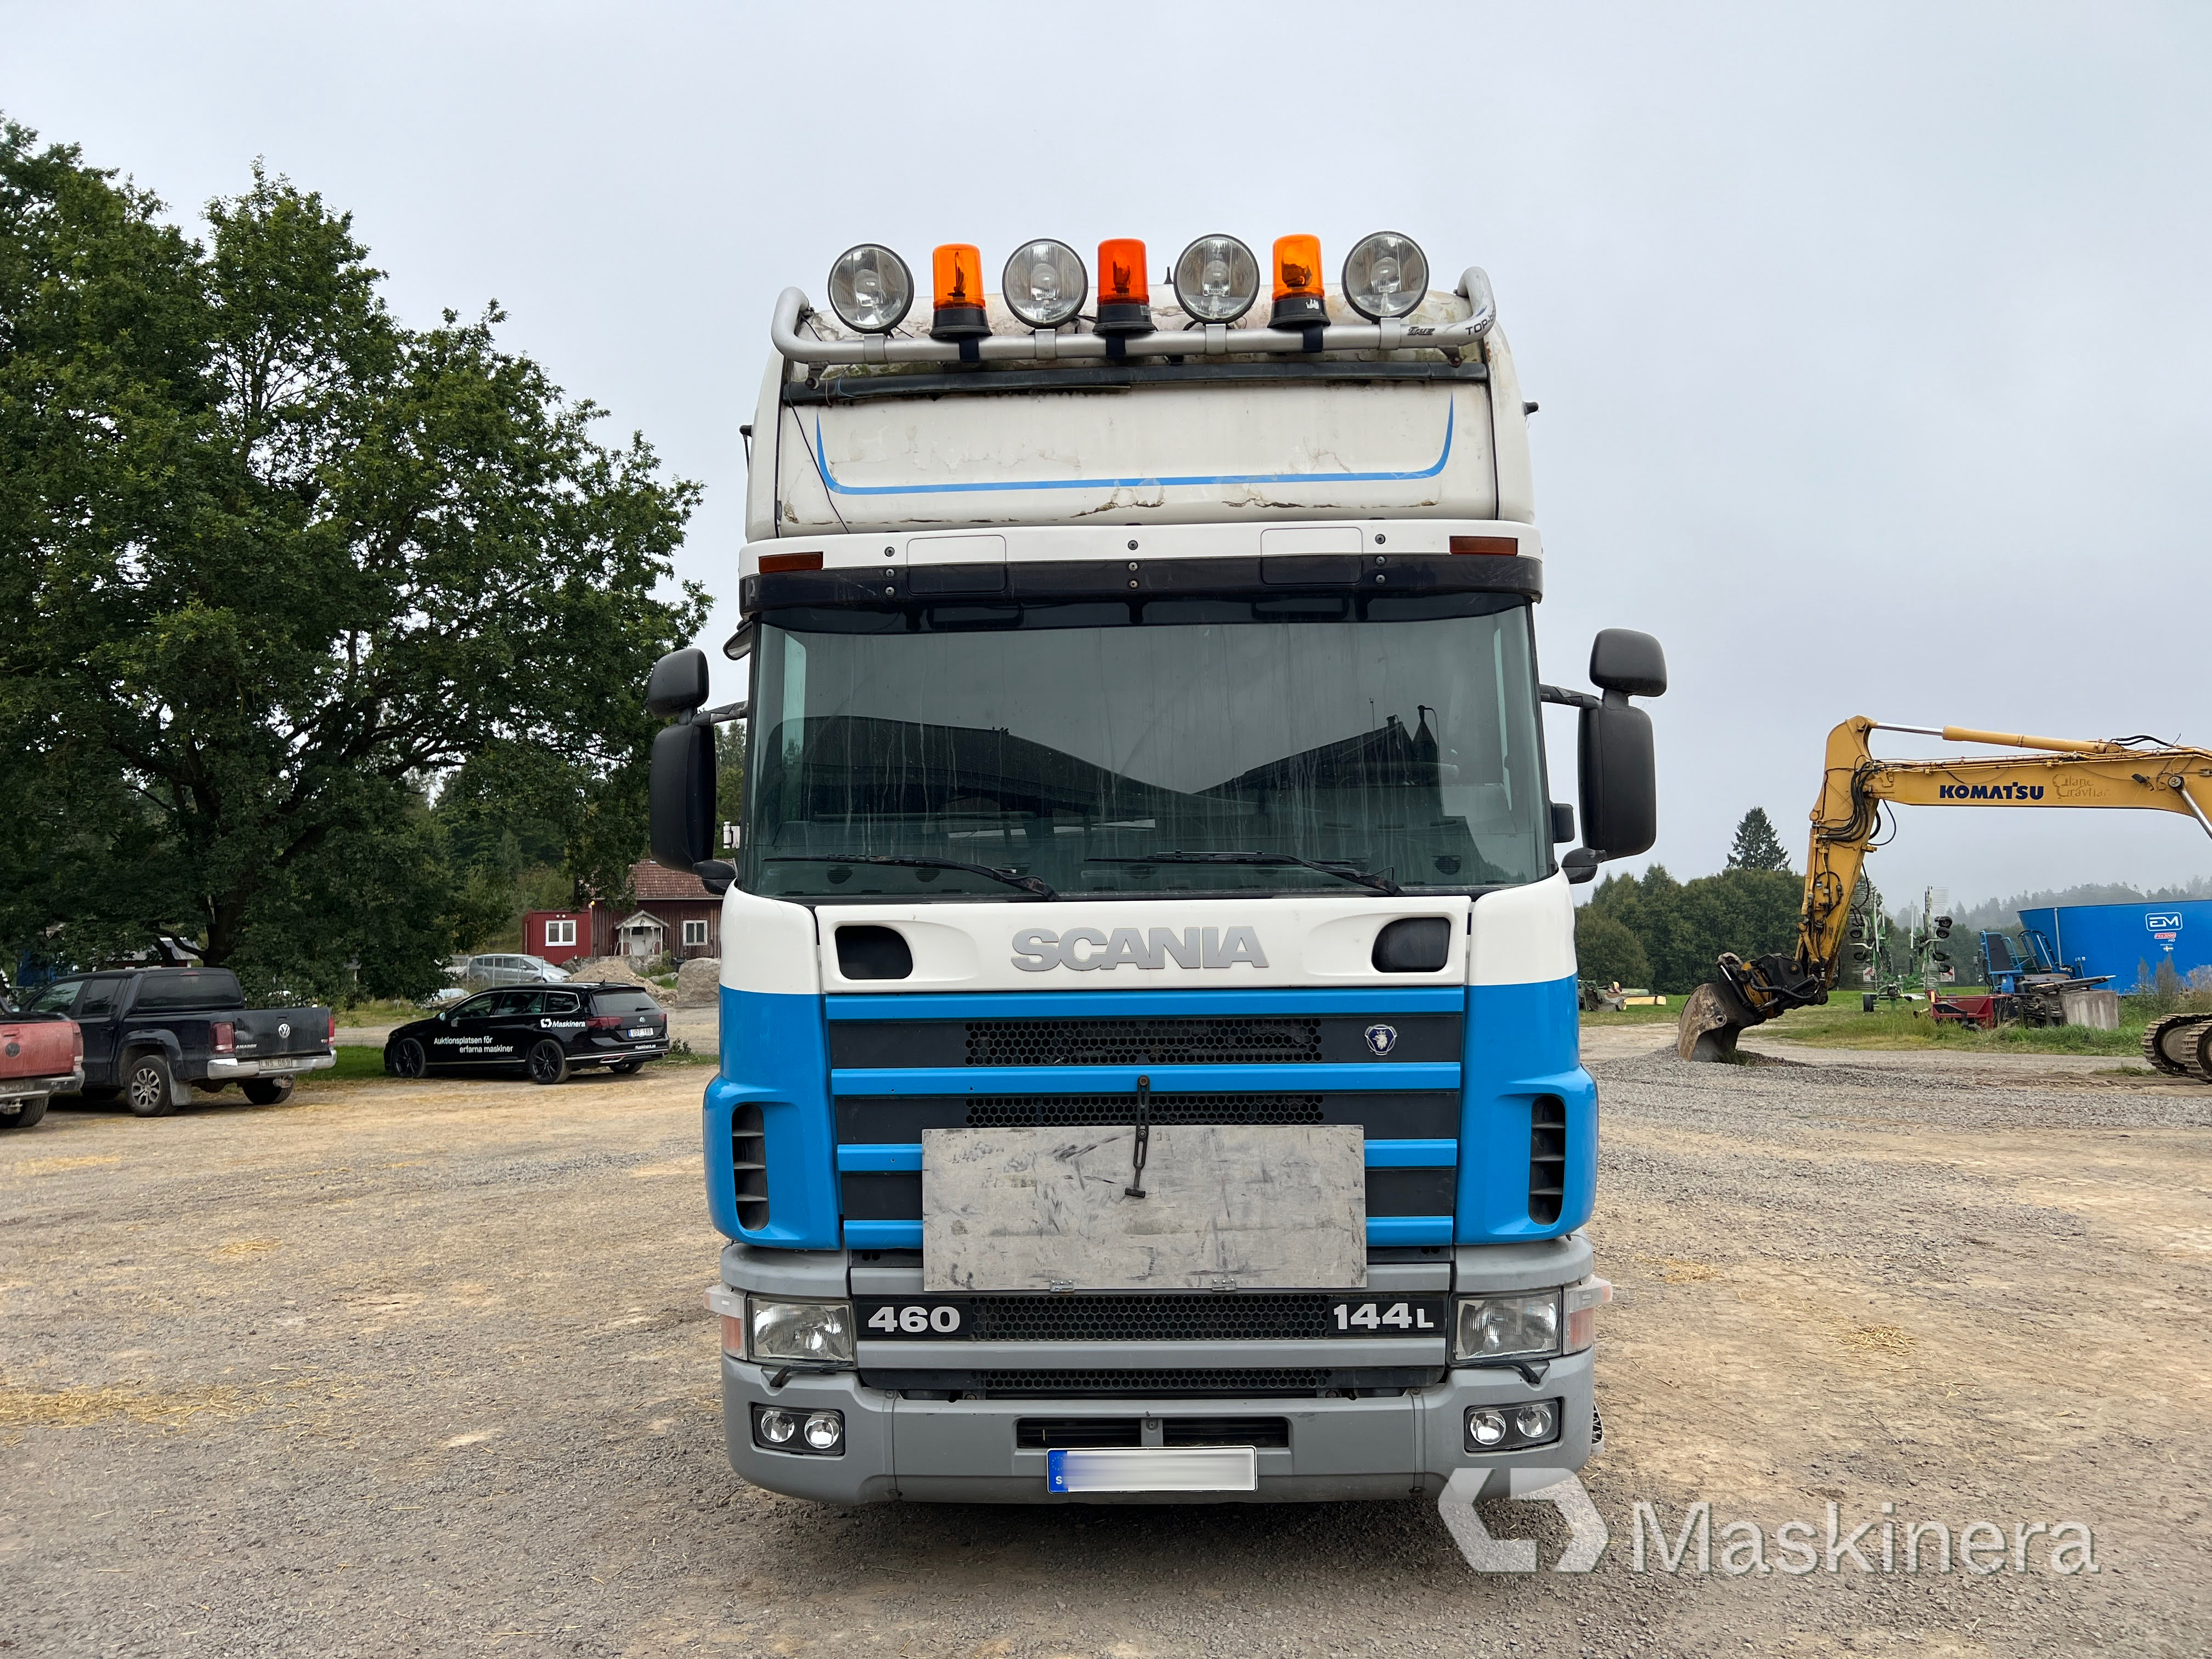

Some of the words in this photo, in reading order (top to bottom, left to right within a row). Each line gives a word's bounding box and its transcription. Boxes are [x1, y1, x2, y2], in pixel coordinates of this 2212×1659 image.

[1940, 782, 2044, 800] KOMATSU
[2149, 916, 2179, 927] EM
[1011, 926, 1269, 972] SCANIA
[434, 1036, 482, 1046] Auktionsplatsen
[483, 1036, 493, 1044] för
[459, 1045, 482, 1053] erfarna
[484, 1044, 514, 1052] maskiner
[868, 1306, 960, 1333] 460
[1334, 1303, 1434, 1330] 144L
[1056, 1475, 1063, 1485] S
